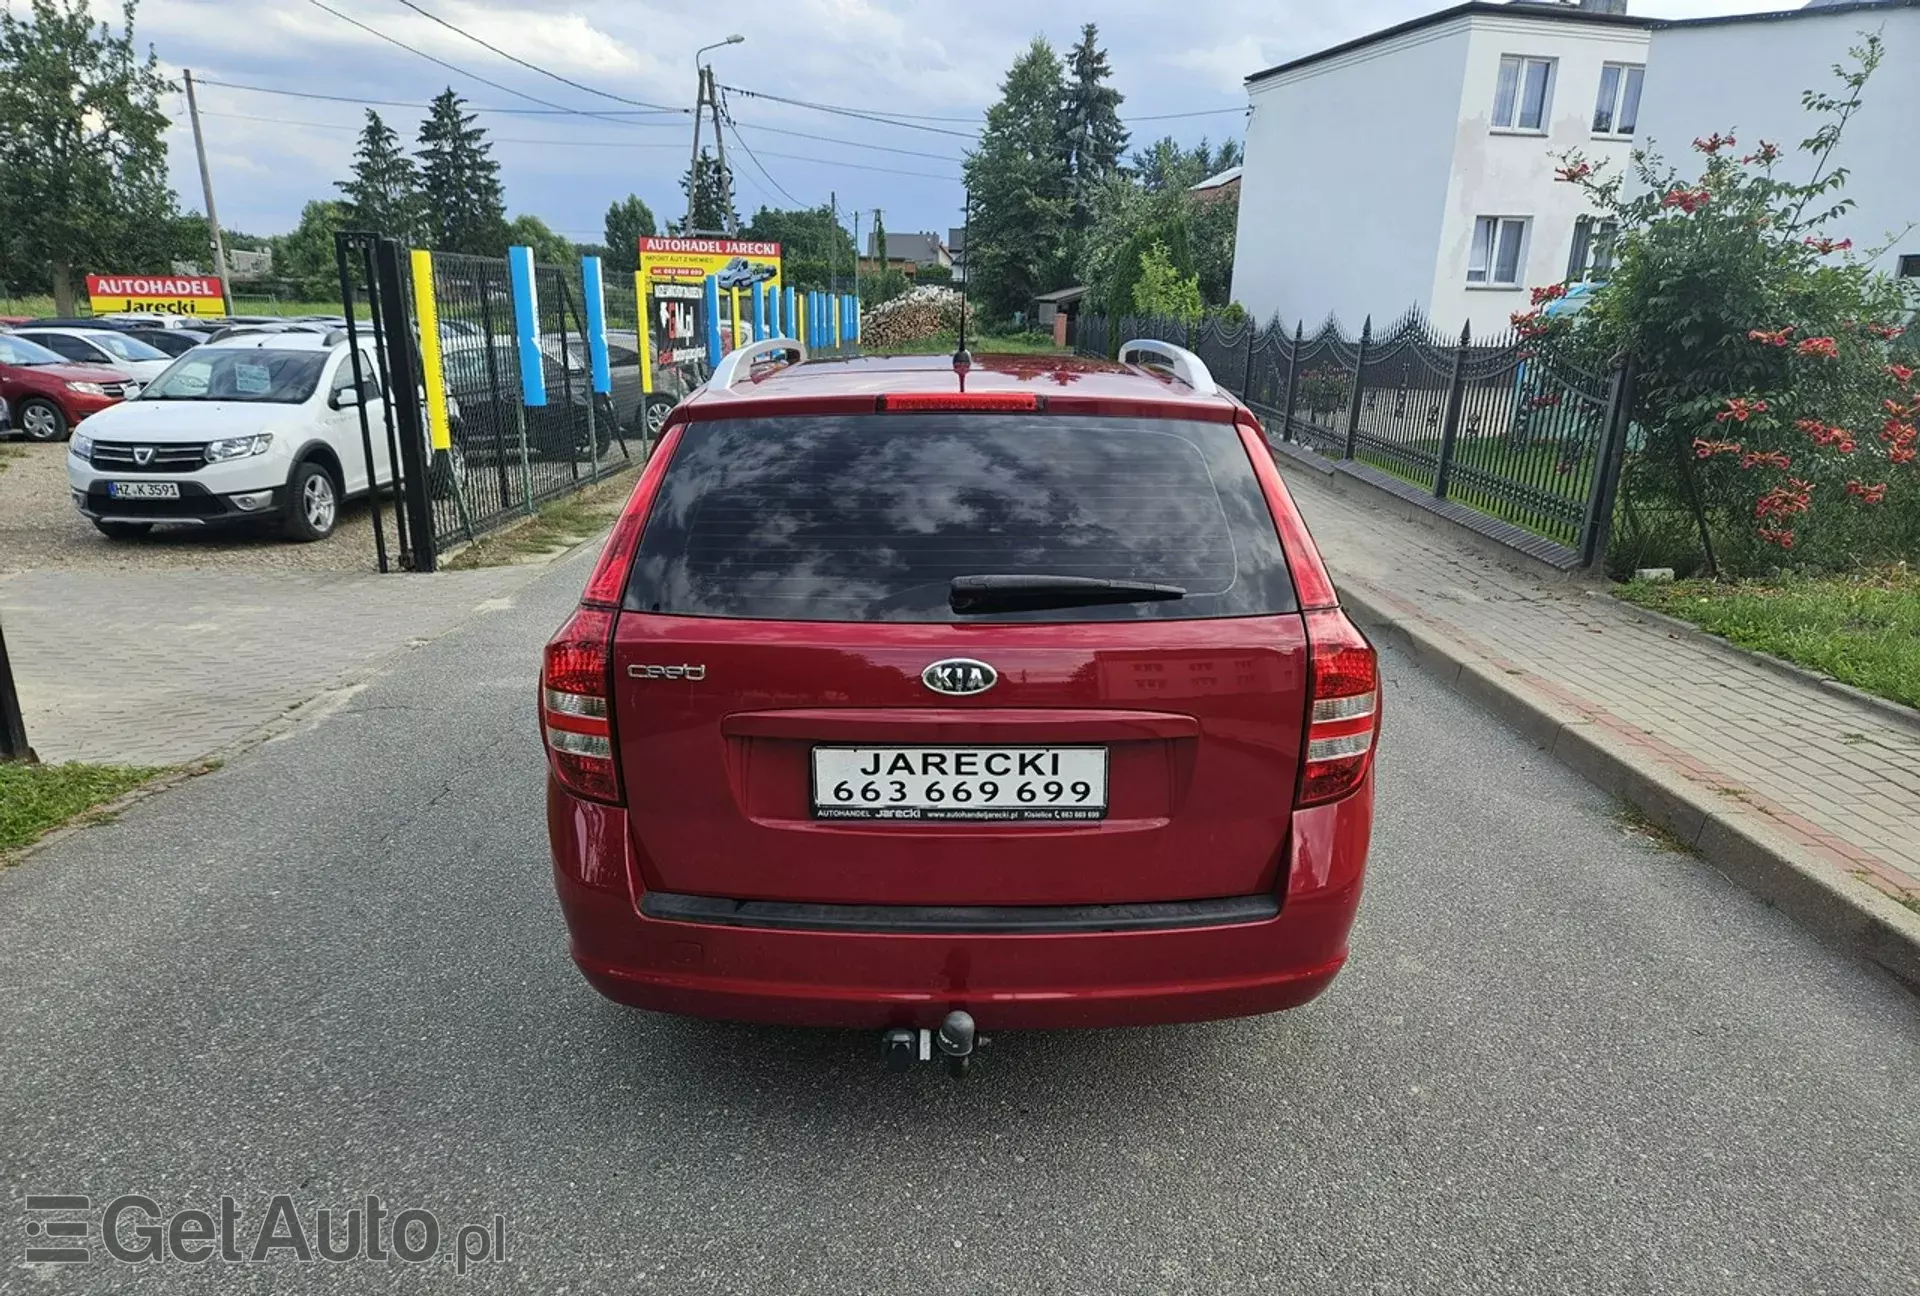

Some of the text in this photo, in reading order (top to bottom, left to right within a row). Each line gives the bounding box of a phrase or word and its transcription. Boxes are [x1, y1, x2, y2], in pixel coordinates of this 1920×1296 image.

[646, 239, 776, 255] AUTOHADEL JARECKI
[97, 279, 213, 295] AUTOHADEL
[121, 299, 196, 315] Jarecki
[137, 484, 145, 495] K
[148, 484, 178, 496] 3591
[935, 666, 985, 690] KIA
[860, 752, 1060, 777] JARECKI
[833, 781, 1091, 803] 663 669 699
[817, 809, 871, 818] AUTOHANDEL
[875, 808, 921, 819] Jarecki
[927, 811, 1018, 820] www.autohandeljarecki.pl
